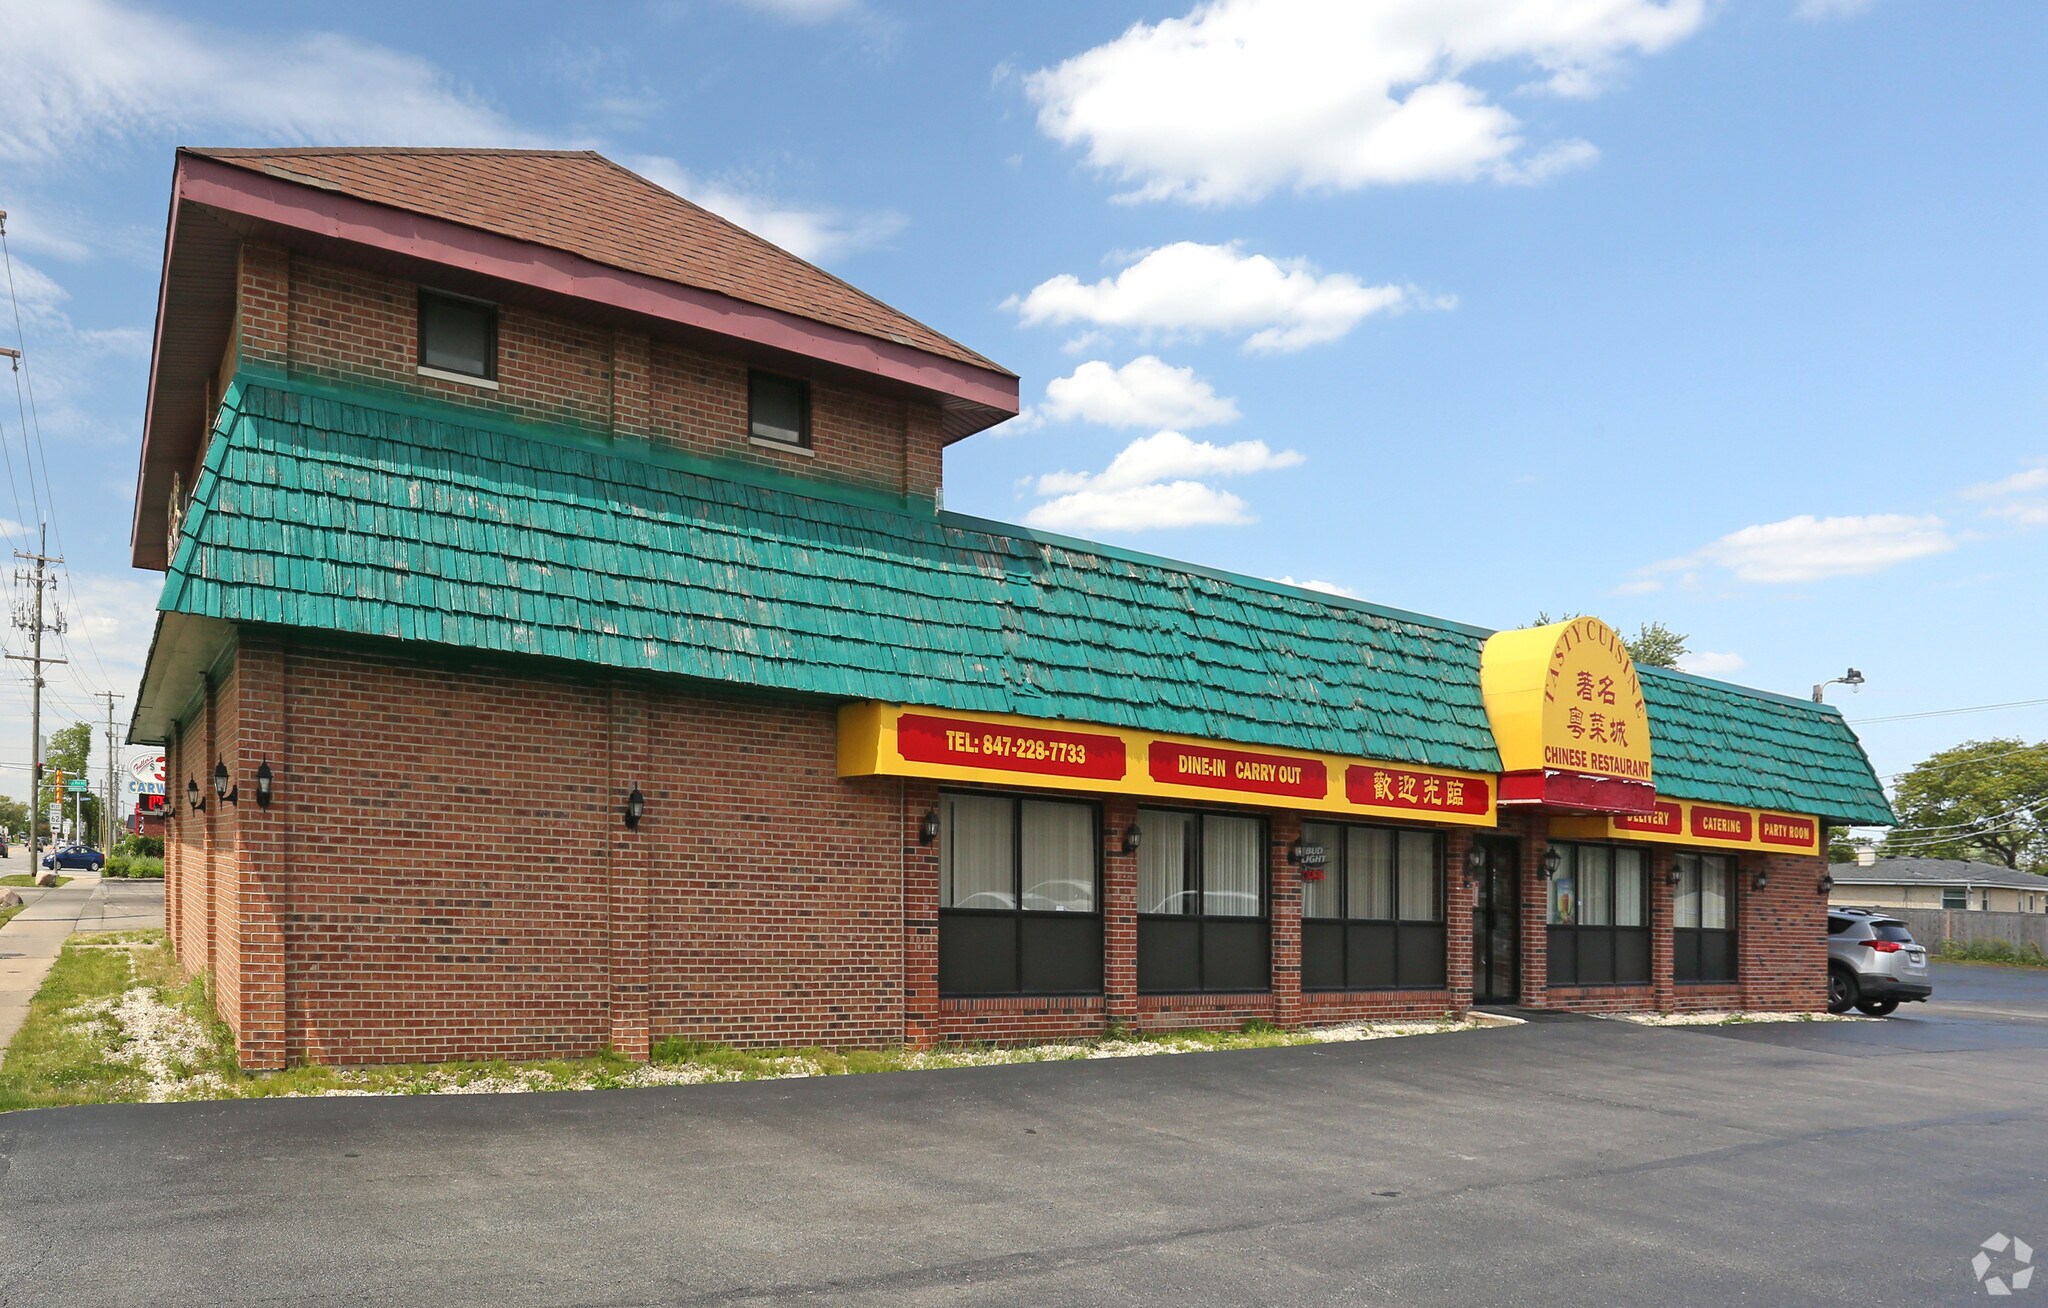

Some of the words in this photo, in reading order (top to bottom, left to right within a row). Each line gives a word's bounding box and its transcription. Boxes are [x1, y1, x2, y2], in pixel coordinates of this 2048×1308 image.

[1576, 670, 1616, 706] 著名
[946, 730, 979, 754] TEL:
[983, 734, 1086, 764] 847-228-7733
[1179, 754, 1226, 777] DINE-IN
[1235, 760, 1276, 782] CARRY
[1279, 765, 1302, 784] OUT
[1545, 745, 1588, 768] CHINESE
[1591, 752, 1650, 778] RESTAURANT
[1373, 771, 1464, 806] 歡迎光臨
[51, 815, 60, 823] 62
[1702, 816, 1742, 833] CATERING
[1764, 822, 1787, 838] PARTY
[1788, 825, 1810, 840] ROOM
[1301, 855, 1326, 863] LIGHT
[1305, 846, 1324, 855] BUD
